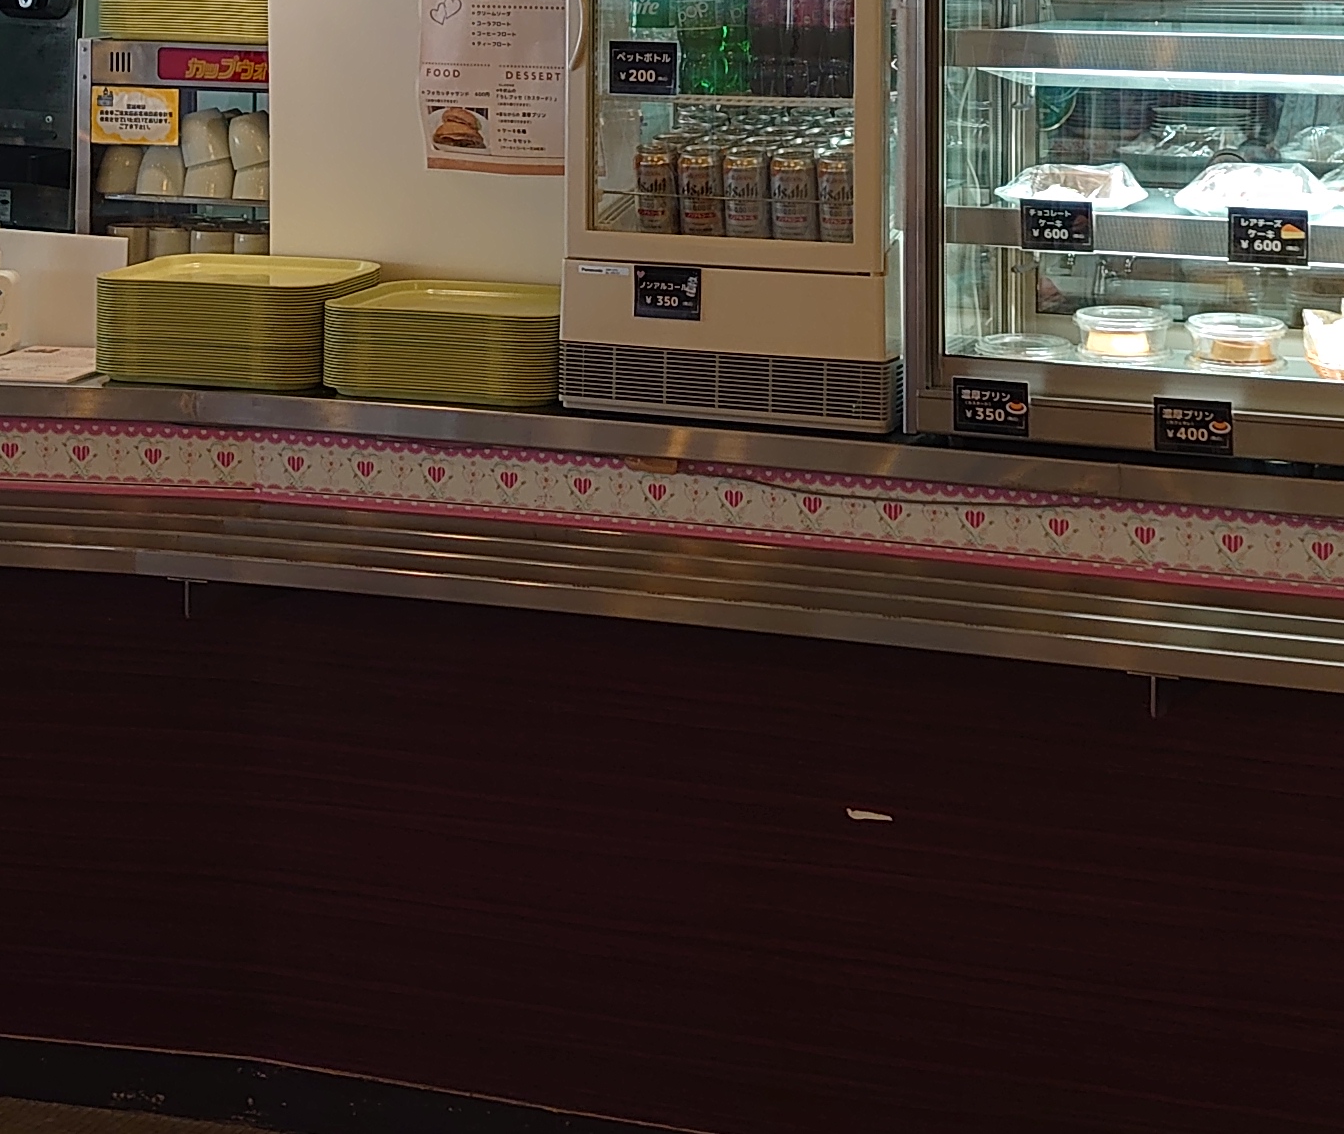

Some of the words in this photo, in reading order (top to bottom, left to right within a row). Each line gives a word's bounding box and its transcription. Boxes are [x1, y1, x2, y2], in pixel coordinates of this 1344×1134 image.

[616, 52, 671, 63] ペットボトル
[426, 68, 461, 78] FOOD
[505, 71, 561, 81] DESSERT
[1028, 208, 1072, 218] チョコレート
[1038, 219, 1063, 227] ケーキ
[1240, 218, 1283, 228] レアチーズ
[1247, 228, 1276, 239] ケーキ
